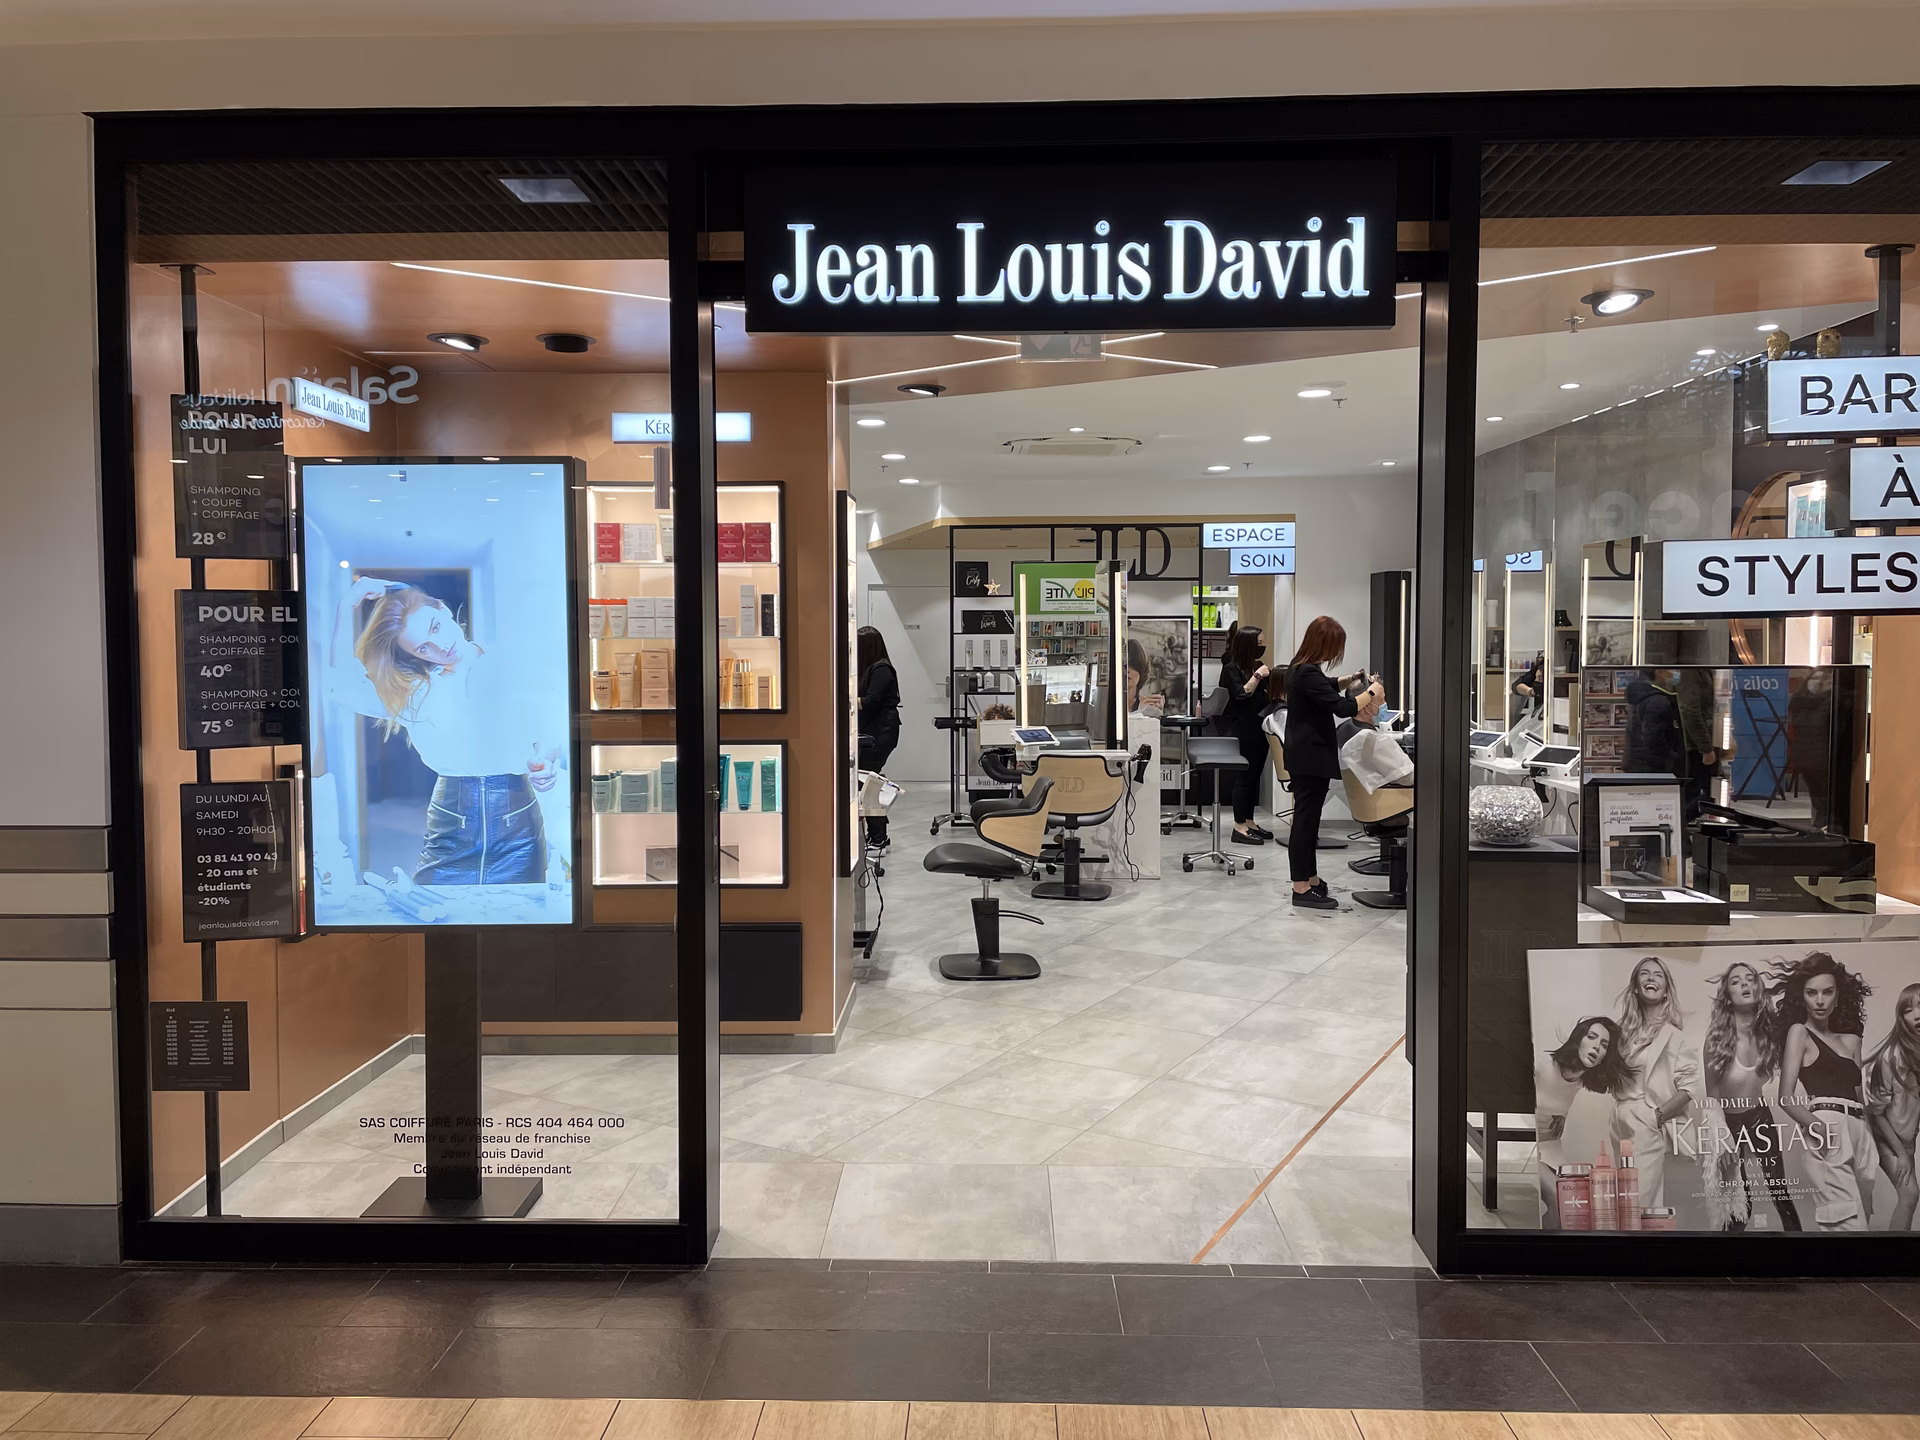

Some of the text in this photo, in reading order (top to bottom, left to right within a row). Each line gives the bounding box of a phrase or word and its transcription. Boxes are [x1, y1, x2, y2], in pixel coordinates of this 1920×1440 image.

[772, 216, 1371, 304] Jean Louis David
[1800, 373, 1919, 416] BAR
[301, 386, 366, 423] Jean Louis David
[188, 436, 227, 455] LUI
[1879, 453, 1920, 507] À
[190, 485, 261, 497] SHAMPOING
[201, 498, 243, 508] COUPE
[202, 510, 260, 520] COIFFAGE
[1212, 527, 1286, 542] ESPACE
[1240, 553, 1286, 568] SOIN
[1696, 551, 1918, 597] STYLES
[198, 606, 265, 623] POUR
[199, 635, 267, 644] SHAMPOING
[210, 647, 265, 656] COIFFAGE
[200, 689, 268, 699] SHAMPOING
[211, 701, 267, 711] COIFFAGE
[195, 793, 268, 804] DU LUNDI AU
[196, 810, 239, 820] SAMEDI
[196, 827, 225, 836] 9H30
[237, 825, 275, 835] 20H00
[197, 852, 278, 864] 03 81 41 90 43
[206, 868, 221, 877] 20
[223, 869, 244, 877] ans
[246, 868, 259, 876] et
[197, 881, 252, 892] étudiants
[198, 896, 231, 906] -20%
[198, 919, 280, 931] jeanlouisdavid.com
[1692, 1098, 1717, 1110] YOU
[1720, 1097, 1756, 1109] DARE,
[359, 1117, 386, 1128] SAS
[389, 1117, 452, 1128] COIFFURE
[456, 1117, 494, 1128] PARIS
[506, 1117, 532, 1128] RCS
[536, 1117, 563, 1128] 404
[567, 1117, 594, 1128] 464
[598, 1117, 625, 1128] 000
[393, 1132, 444, 1143] Membre
[469, 1133, 511, 1143] réseau
[515, 1132, 530, 1143] de
[534, 1132, 591, 1143] franchise
[1671, 1116, 1840, 1156] KÉRASTASE
[441, 1148, 544, 1159] Jean Louis David
[1739, 1156, 1777, 1168] PARIS
[497, 1163, 572, 1177] indépendant
[1718, 1178, 1800, 1188] CHROMA ABSOLU
